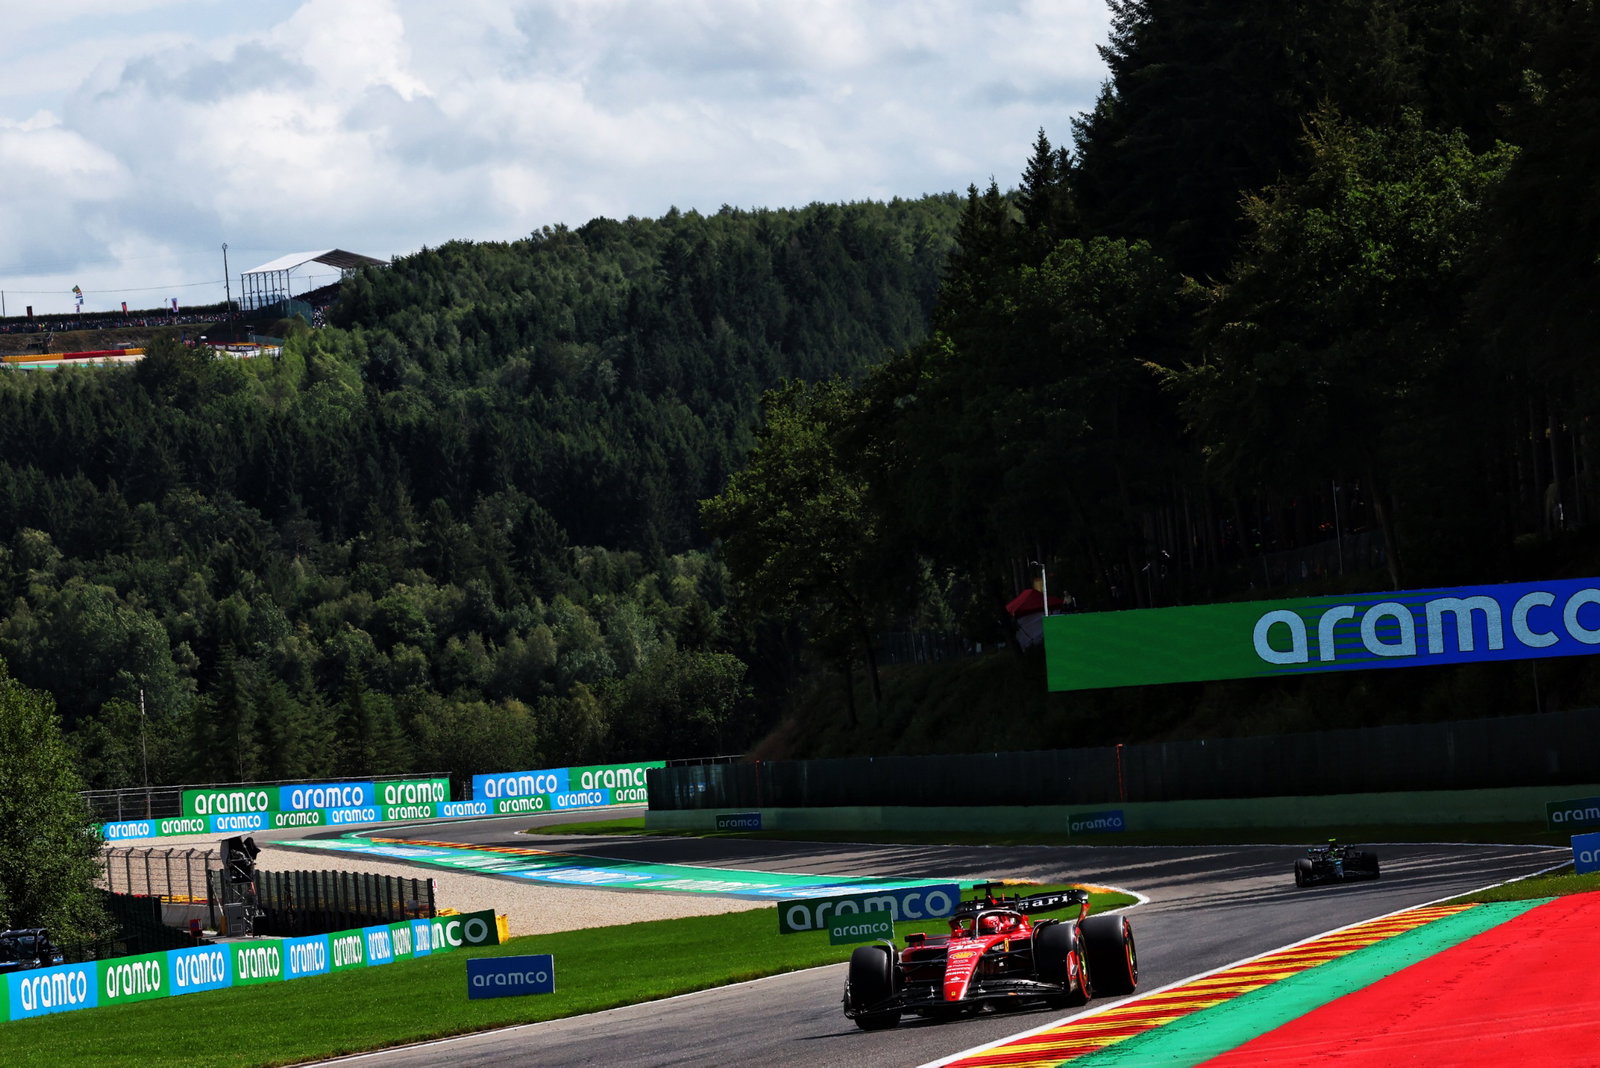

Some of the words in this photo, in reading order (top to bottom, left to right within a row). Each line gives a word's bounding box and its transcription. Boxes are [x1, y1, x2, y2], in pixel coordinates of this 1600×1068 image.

[385, 782, 445, 805] aramco
[485, 775, 558, 798] aramco
[615, 787, 647, 802] aram
[194, 791, 268, 815] aramco
[291, 785, 364, 810] aramco
[499, 797, 543, 813] aramco
[557, 791, 602, 807] aramco
[331, 808, 375, 823] aramco
[387, 805, 431, 821] aramco
[443, 802, 487, 816] aramco
[161, 818, 204, 834] aramco
[216, 815, 261, 830] aramco
[276, 811, 320, 827] aramco
[719, 819, 759, 828] aramco
[1071, 817, 1122, 831] aramco
[109, 822, 149, 838] aramco
[787, 890, 952, 930] aramco
[833, 921, 889, 937] aramco
[290, 941, 325, 973] aramco
[333, 935, 362, 966] aramco
[176, 952, 224, 987] aramco
[237, 947, 280, 978] aramco
[106, 960, 160, 998] aramco
[473, 971, 548, 986] aramco
[21, 970, 86, 1010] aramco
